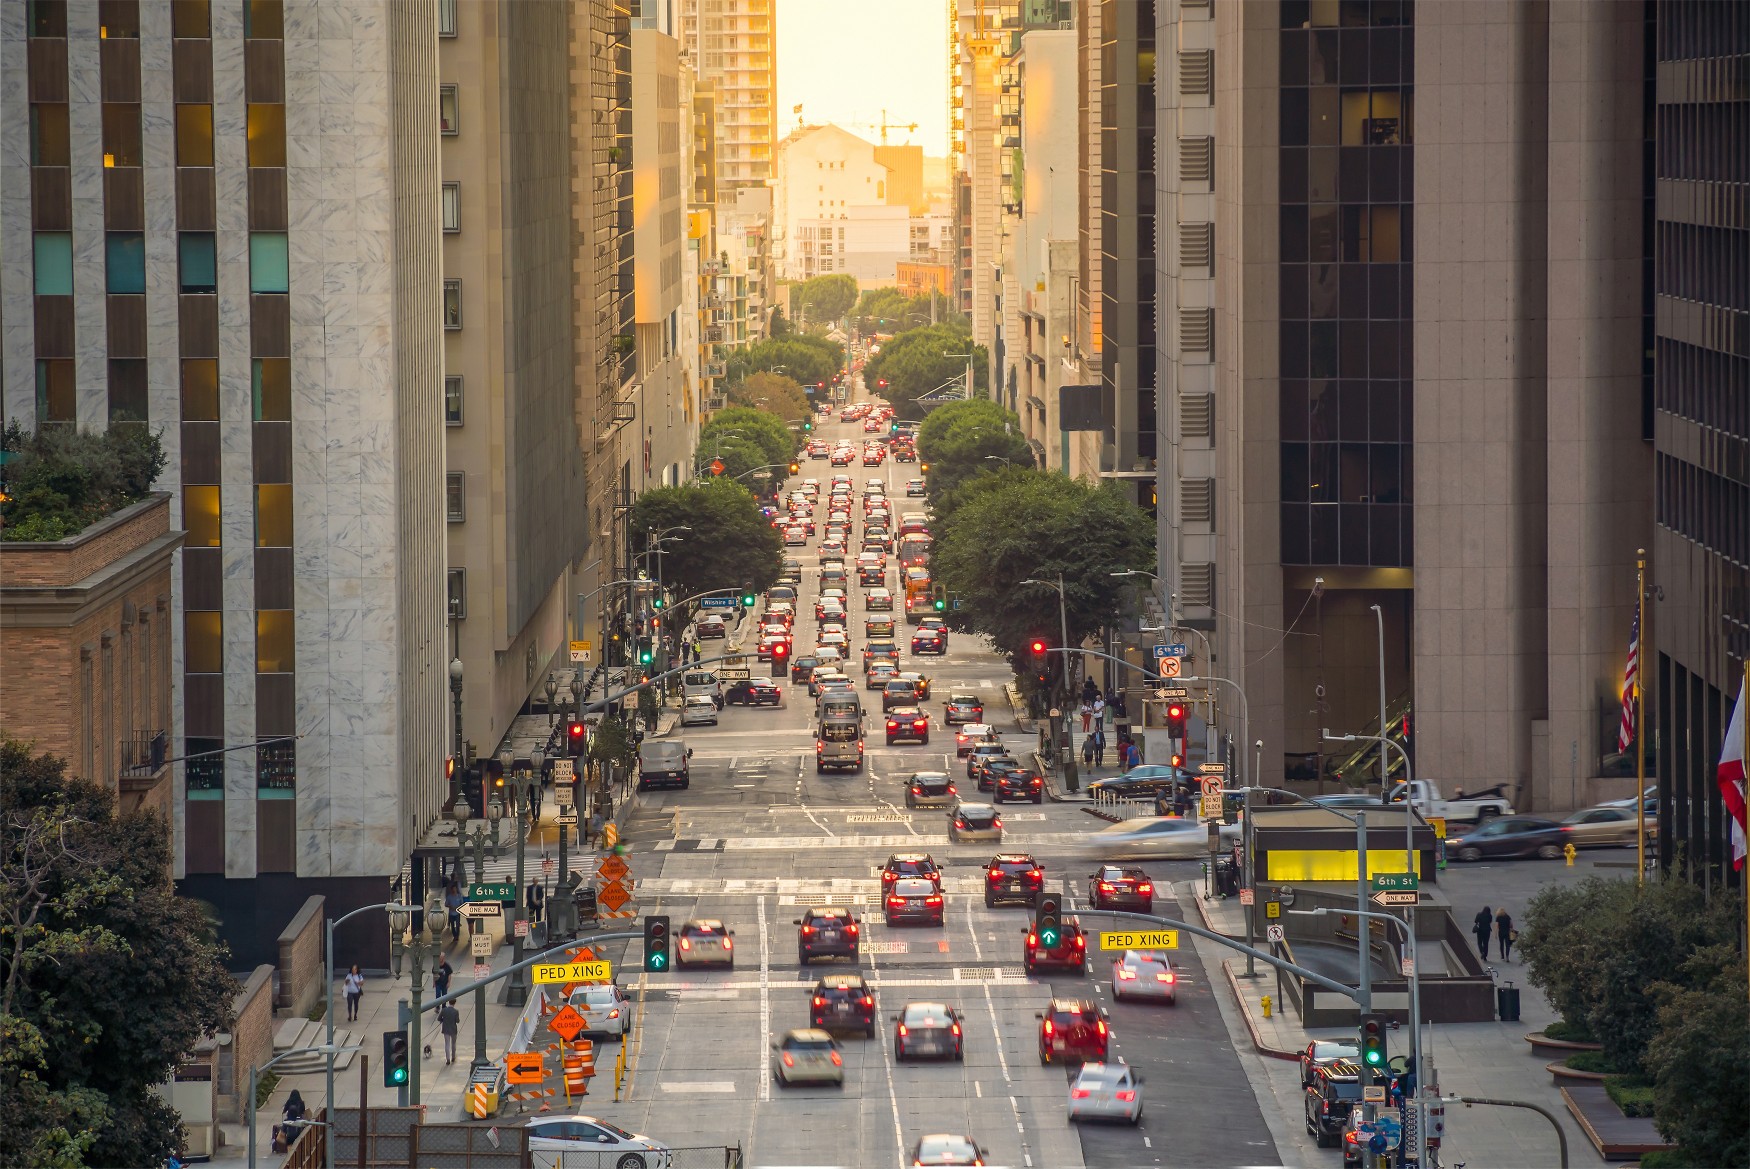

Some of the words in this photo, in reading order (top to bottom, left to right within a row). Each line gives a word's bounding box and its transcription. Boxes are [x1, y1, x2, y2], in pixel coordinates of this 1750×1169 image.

[1157, 647, 1171, 656] 6th
[1378, 876, 1396, 886] 6th
[1402, 877, 1413, 885] St
[475, 886, 494, 896] 6th
[499, 887, 509, 895] St
[1108, 935, 1133, 946] PED
[1139, 934, 1170, 945] XING
[540, 968, 566, 979] PED
[572, 964, 603, 978] XING
[557, 1021, 580, 1029] CLOSED
